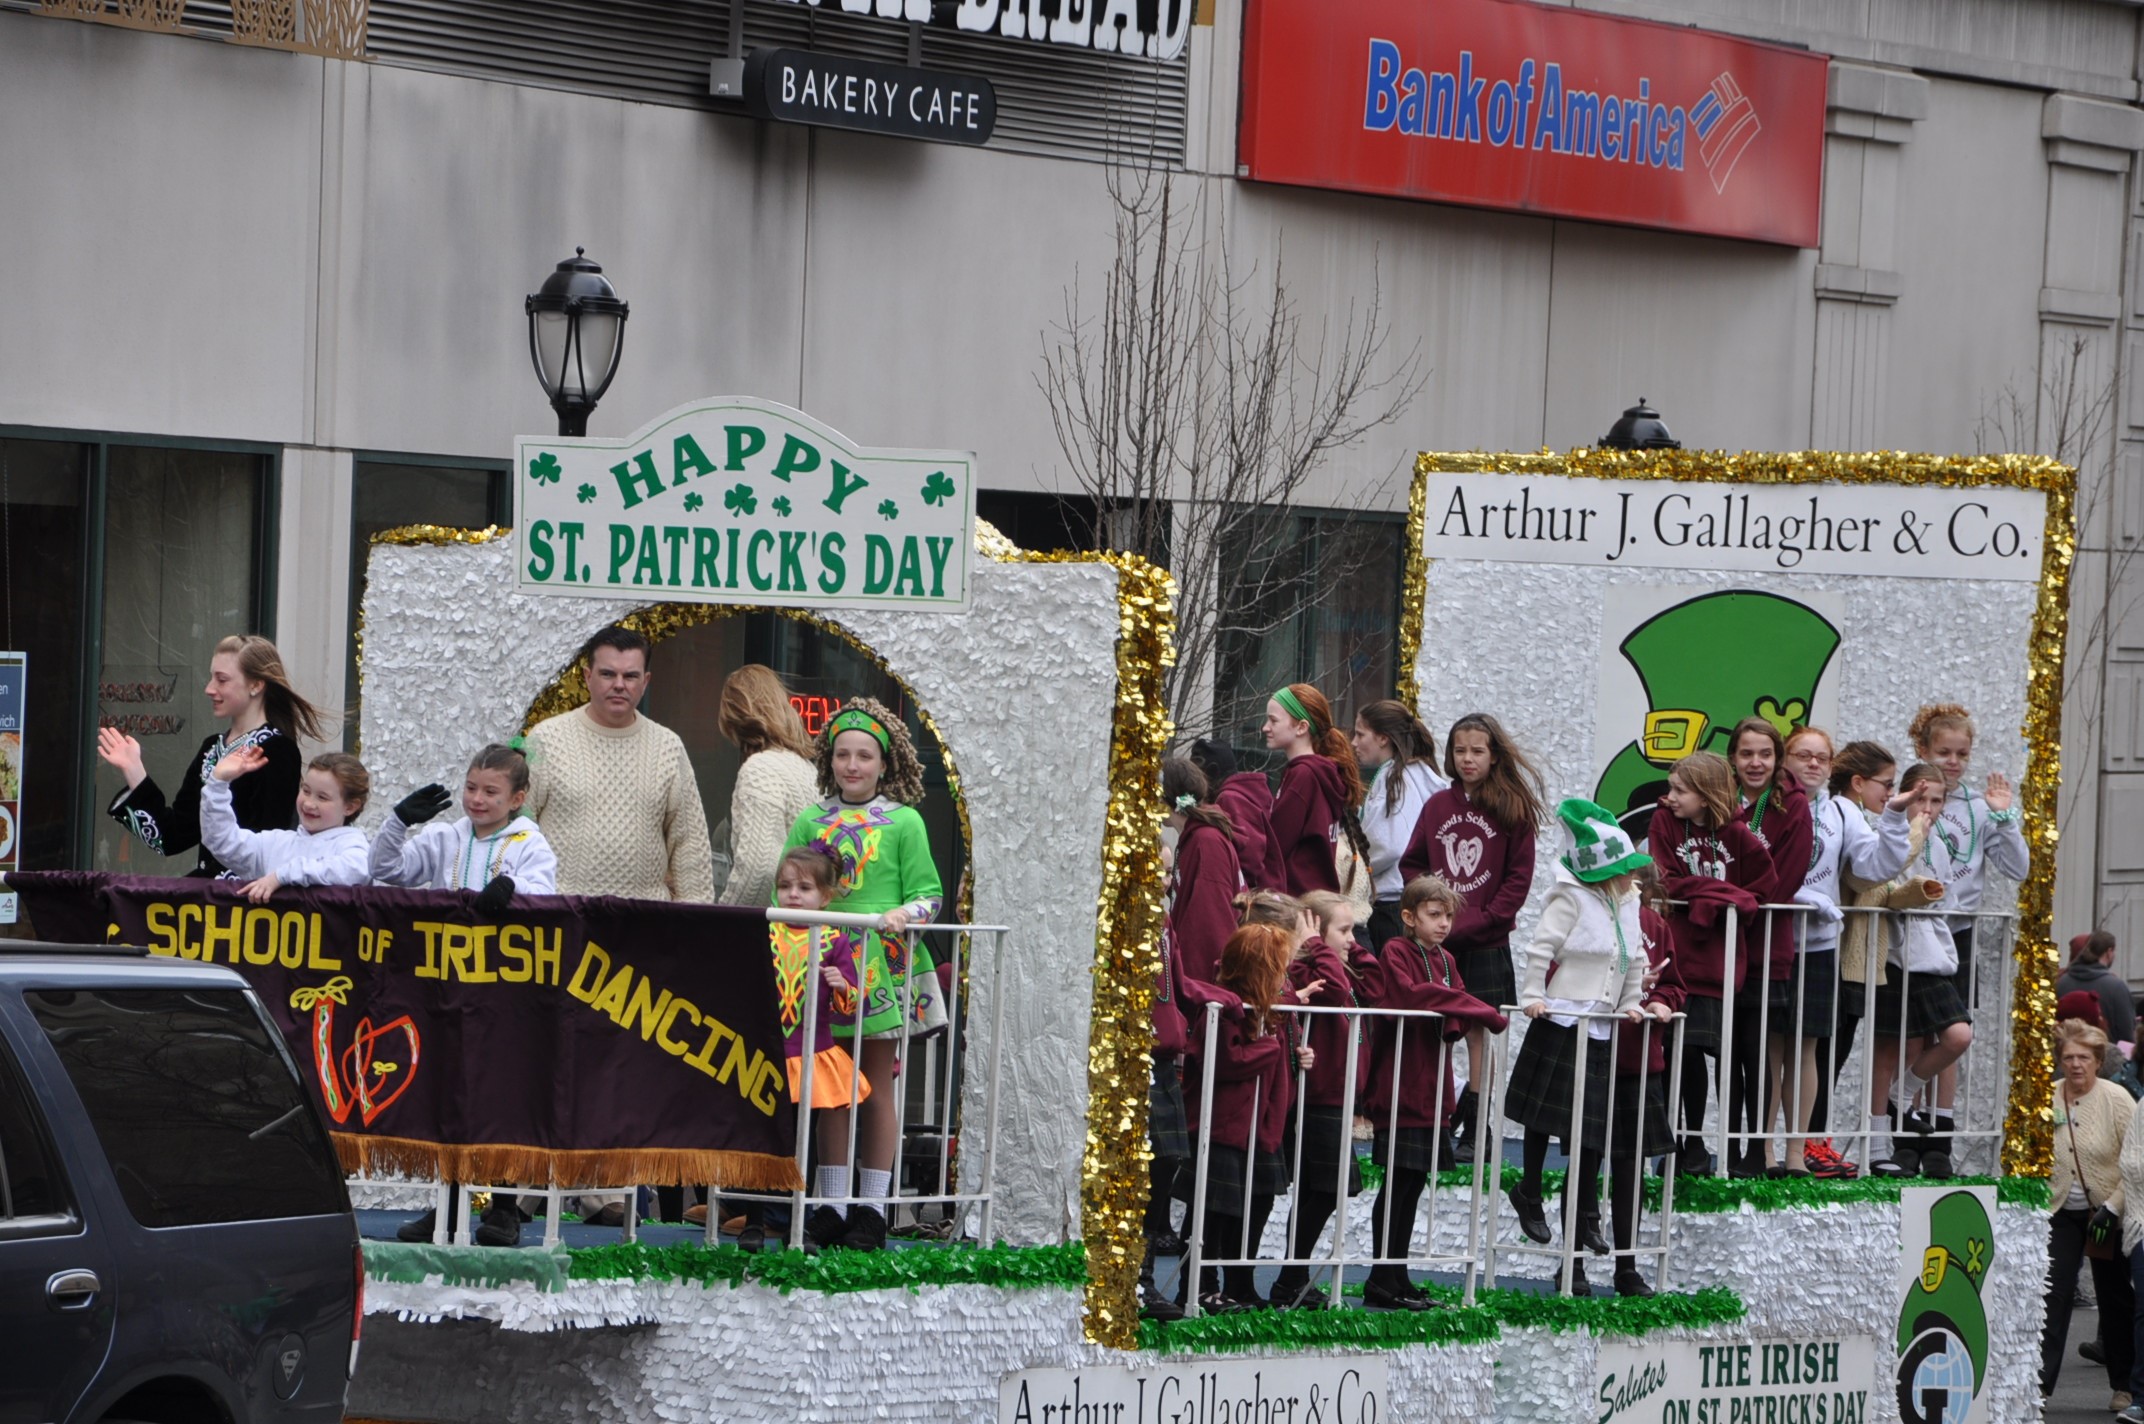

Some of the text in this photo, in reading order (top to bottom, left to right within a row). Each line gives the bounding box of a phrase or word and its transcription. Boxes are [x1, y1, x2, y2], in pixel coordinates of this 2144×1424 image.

[782, 66, 979, 129] BAKERY CAFE
[1363, 37, 1686, 171] Bank of America
[609, 425, 869, 515] HAPPY
[527, 519, 954, 597] ST. PATRICK'S DAY
[1436, 485, 2029, 568] Arthur J. Gallagher & Co.
[1435, 811, 1497, 840] Woods School
[1453, 869, 1492, 892] Dancing
[1803, 866, 1832, 886] ncing
[146, 902, 785, 1117] SCHOOL OF IRISH DANCING
[1014, 1376, 1125, 1424] Arthur
[1156, 1372, 1299, 1424] Gallagher
[1305, 1383, 1329, 1424] &
[1337, 1369, 1379, 1424] Co
[1599, 1358, 1668, 1424] Salutes
[1699, 1342, 1840, 1388] THE IRISH
[1662, 1390, 1868, 1424] ON ST PATRICK'S DAY
